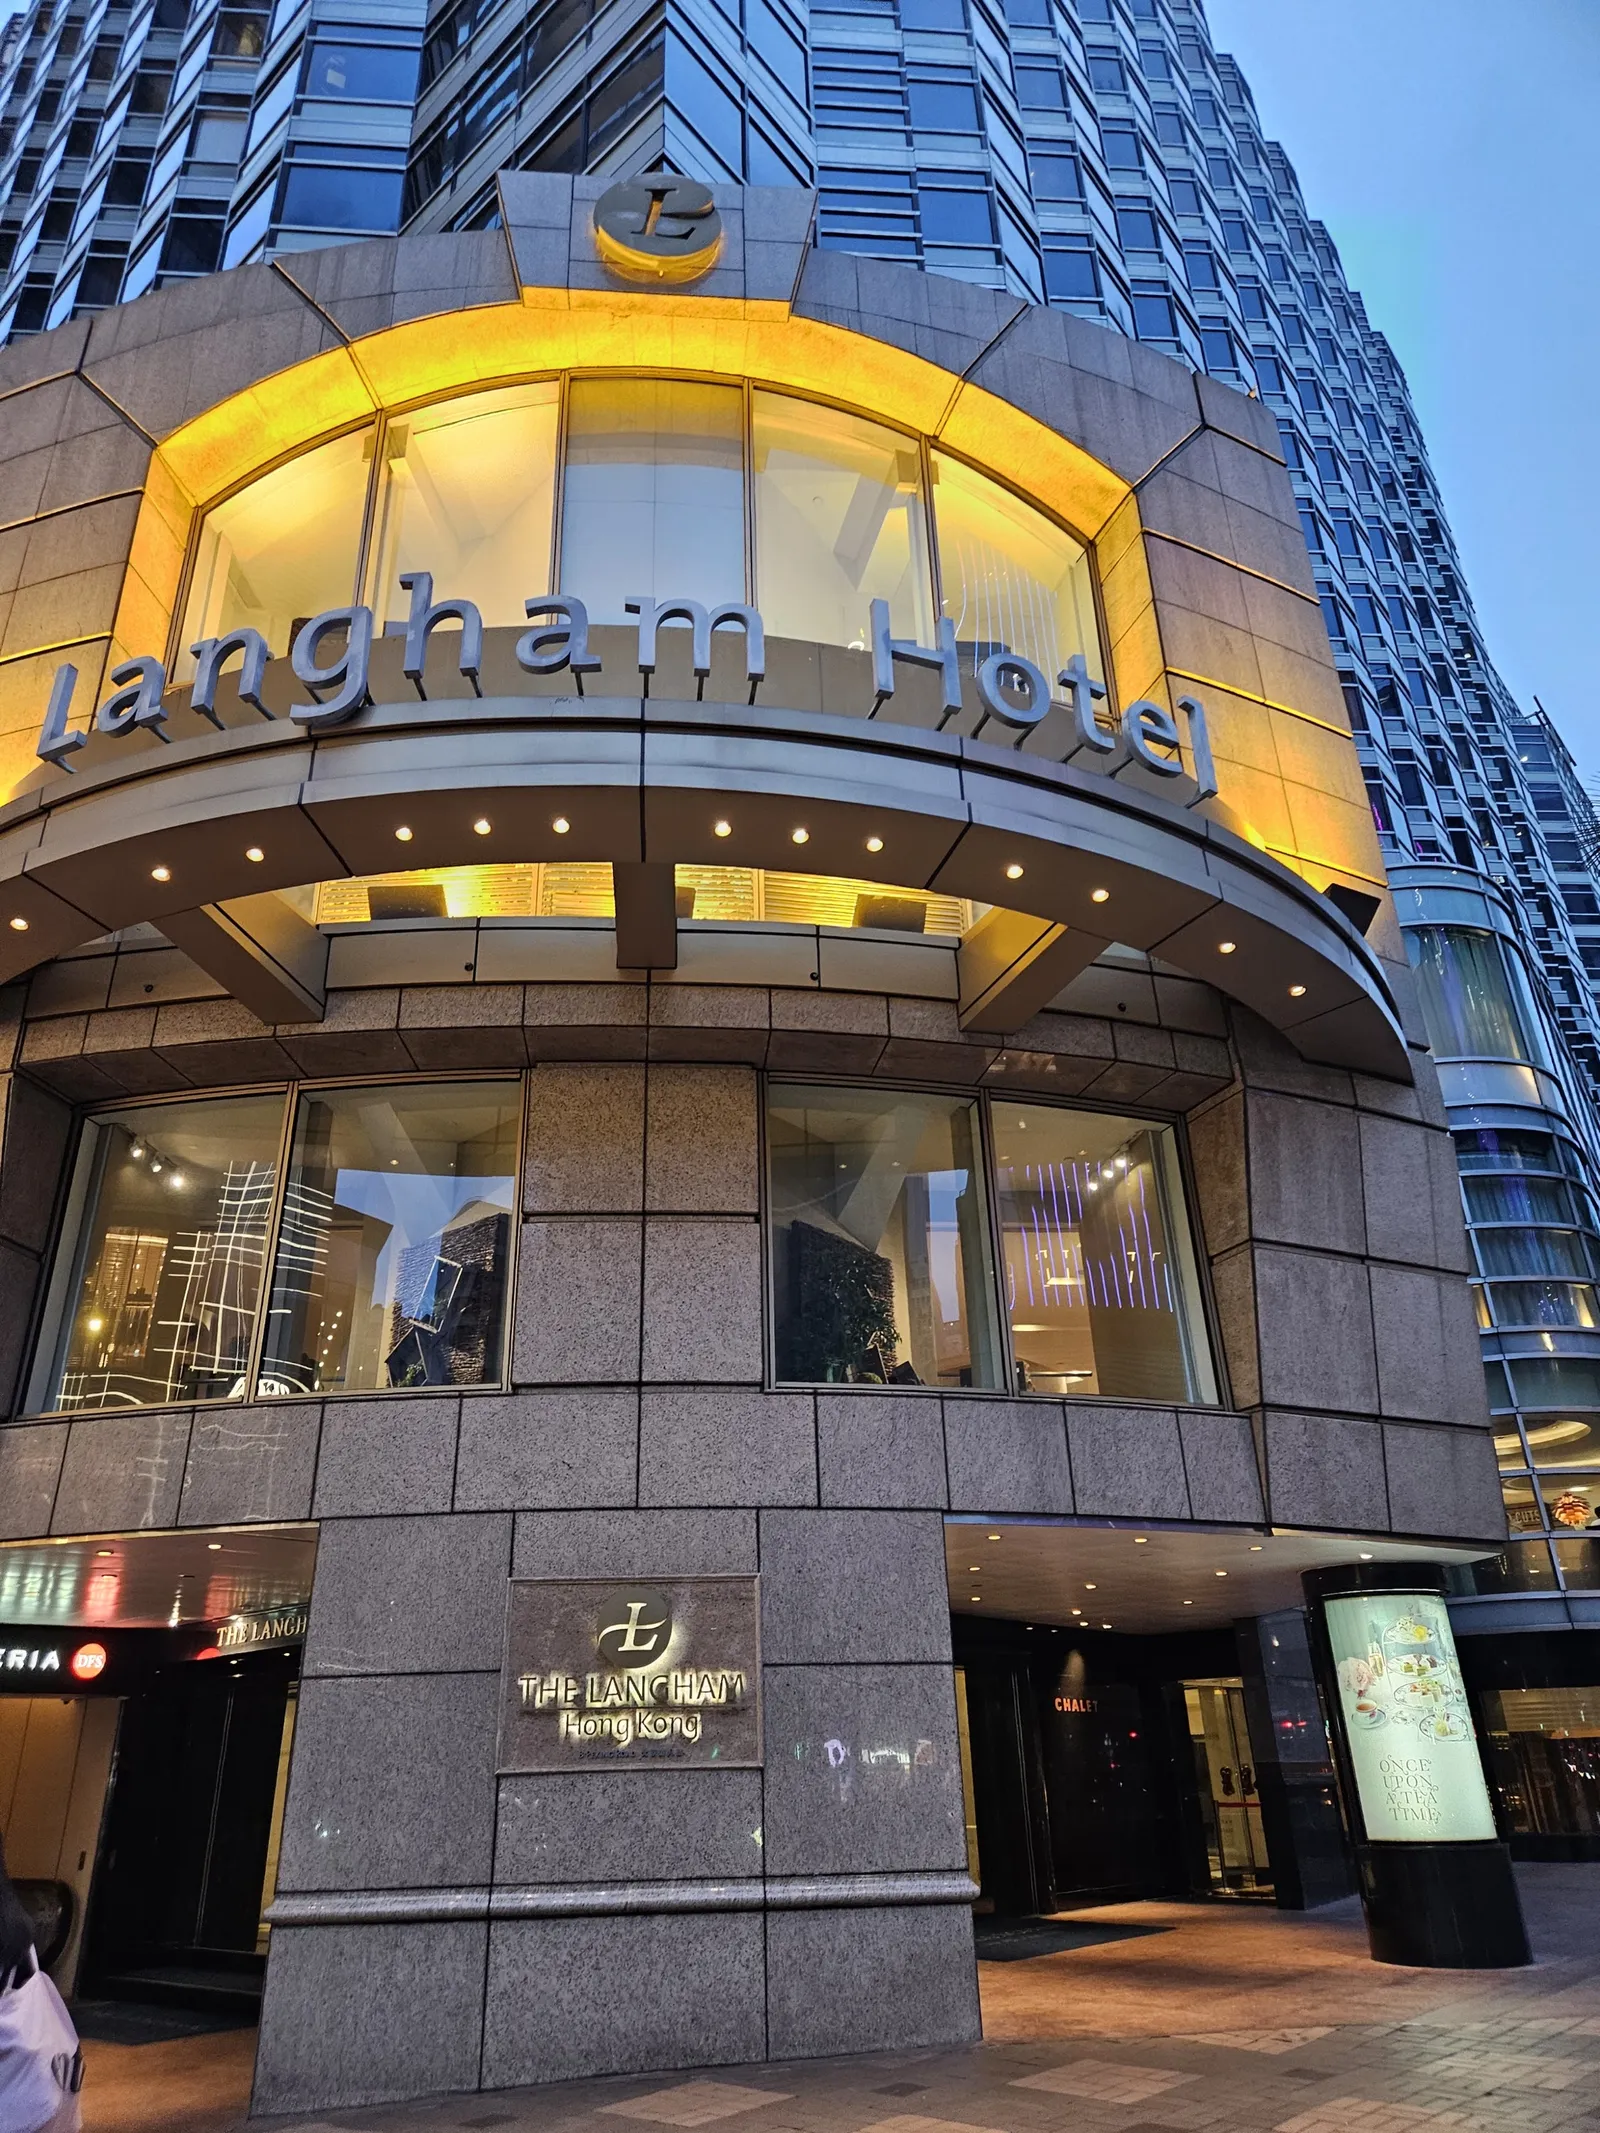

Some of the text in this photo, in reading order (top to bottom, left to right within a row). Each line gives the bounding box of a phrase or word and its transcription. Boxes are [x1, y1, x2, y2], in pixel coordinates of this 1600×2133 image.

[36, 572, 1219, 800] Langham Hotel
[216, 1623, 249, 1647] THE
[79, 1653, 104, 1669] DFS
[519, 1672, 745, 1705] THE LANGHAM
[1055, 1697, 1098, 1712] CHALET
[563, 1710, 701, 1743] Hong Kong
[1379, 1754, 1432, 1775] ONCE
[1383, 1773, 1439, 1792] UPON
[1386, 1788, 1438, 1807] A TEA
[1388, 1803, 1441, 1824] TIME
